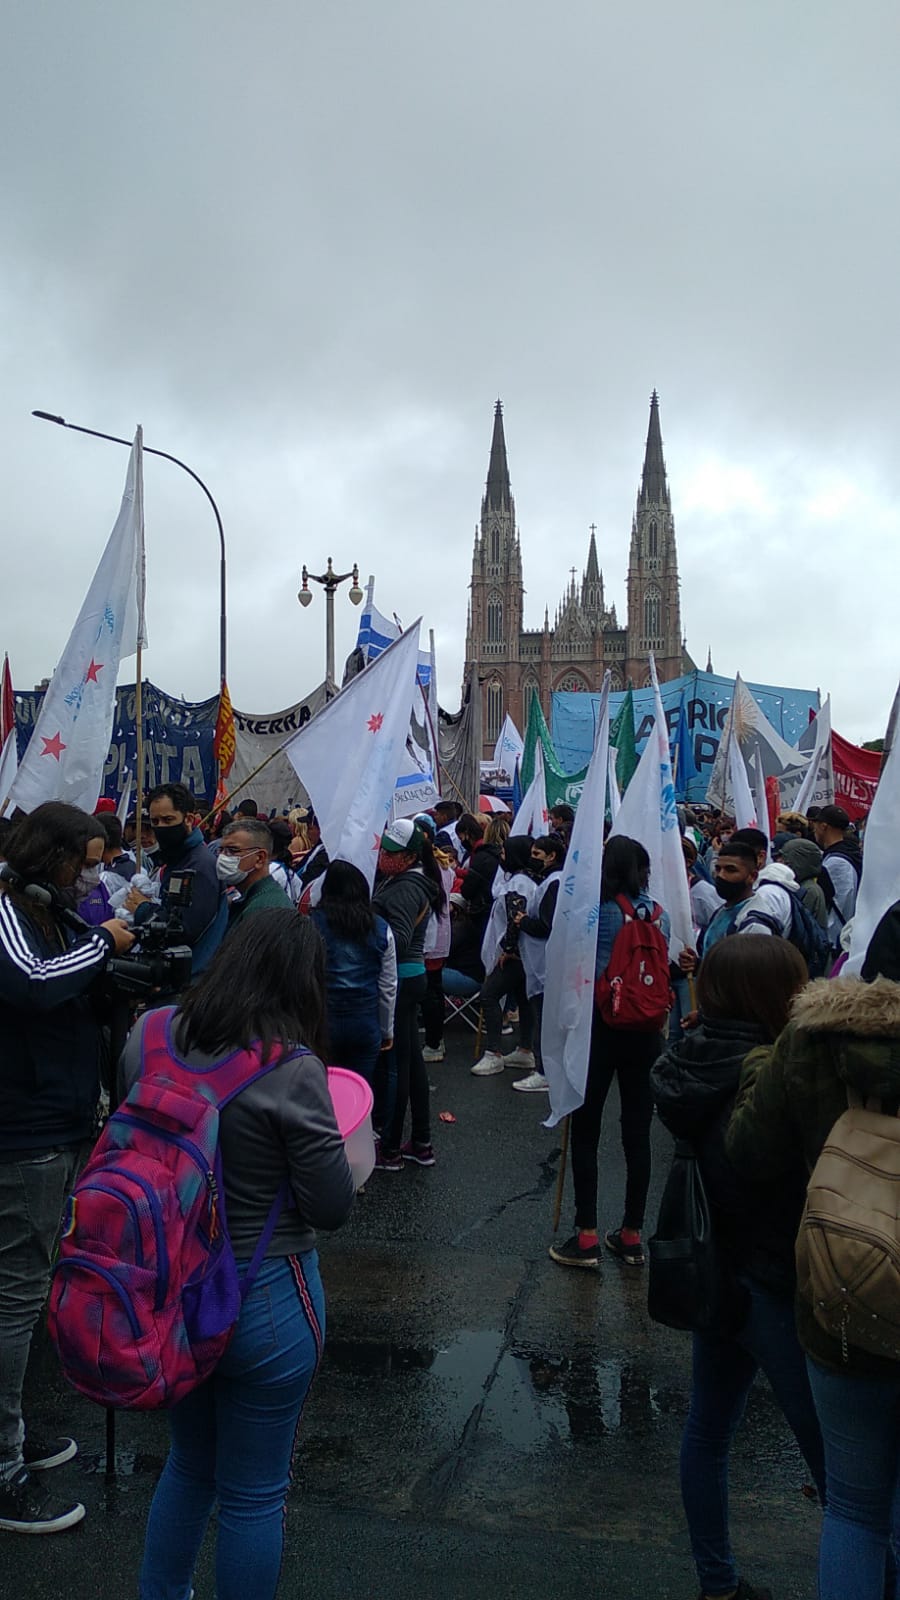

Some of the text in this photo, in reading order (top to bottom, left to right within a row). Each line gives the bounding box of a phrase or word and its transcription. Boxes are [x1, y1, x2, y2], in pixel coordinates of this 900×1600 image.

[232, 705, 311, 734] TIERRA
[101, 738, 207, 796] PLATA
[833, 770, 879, 801] NUEST
